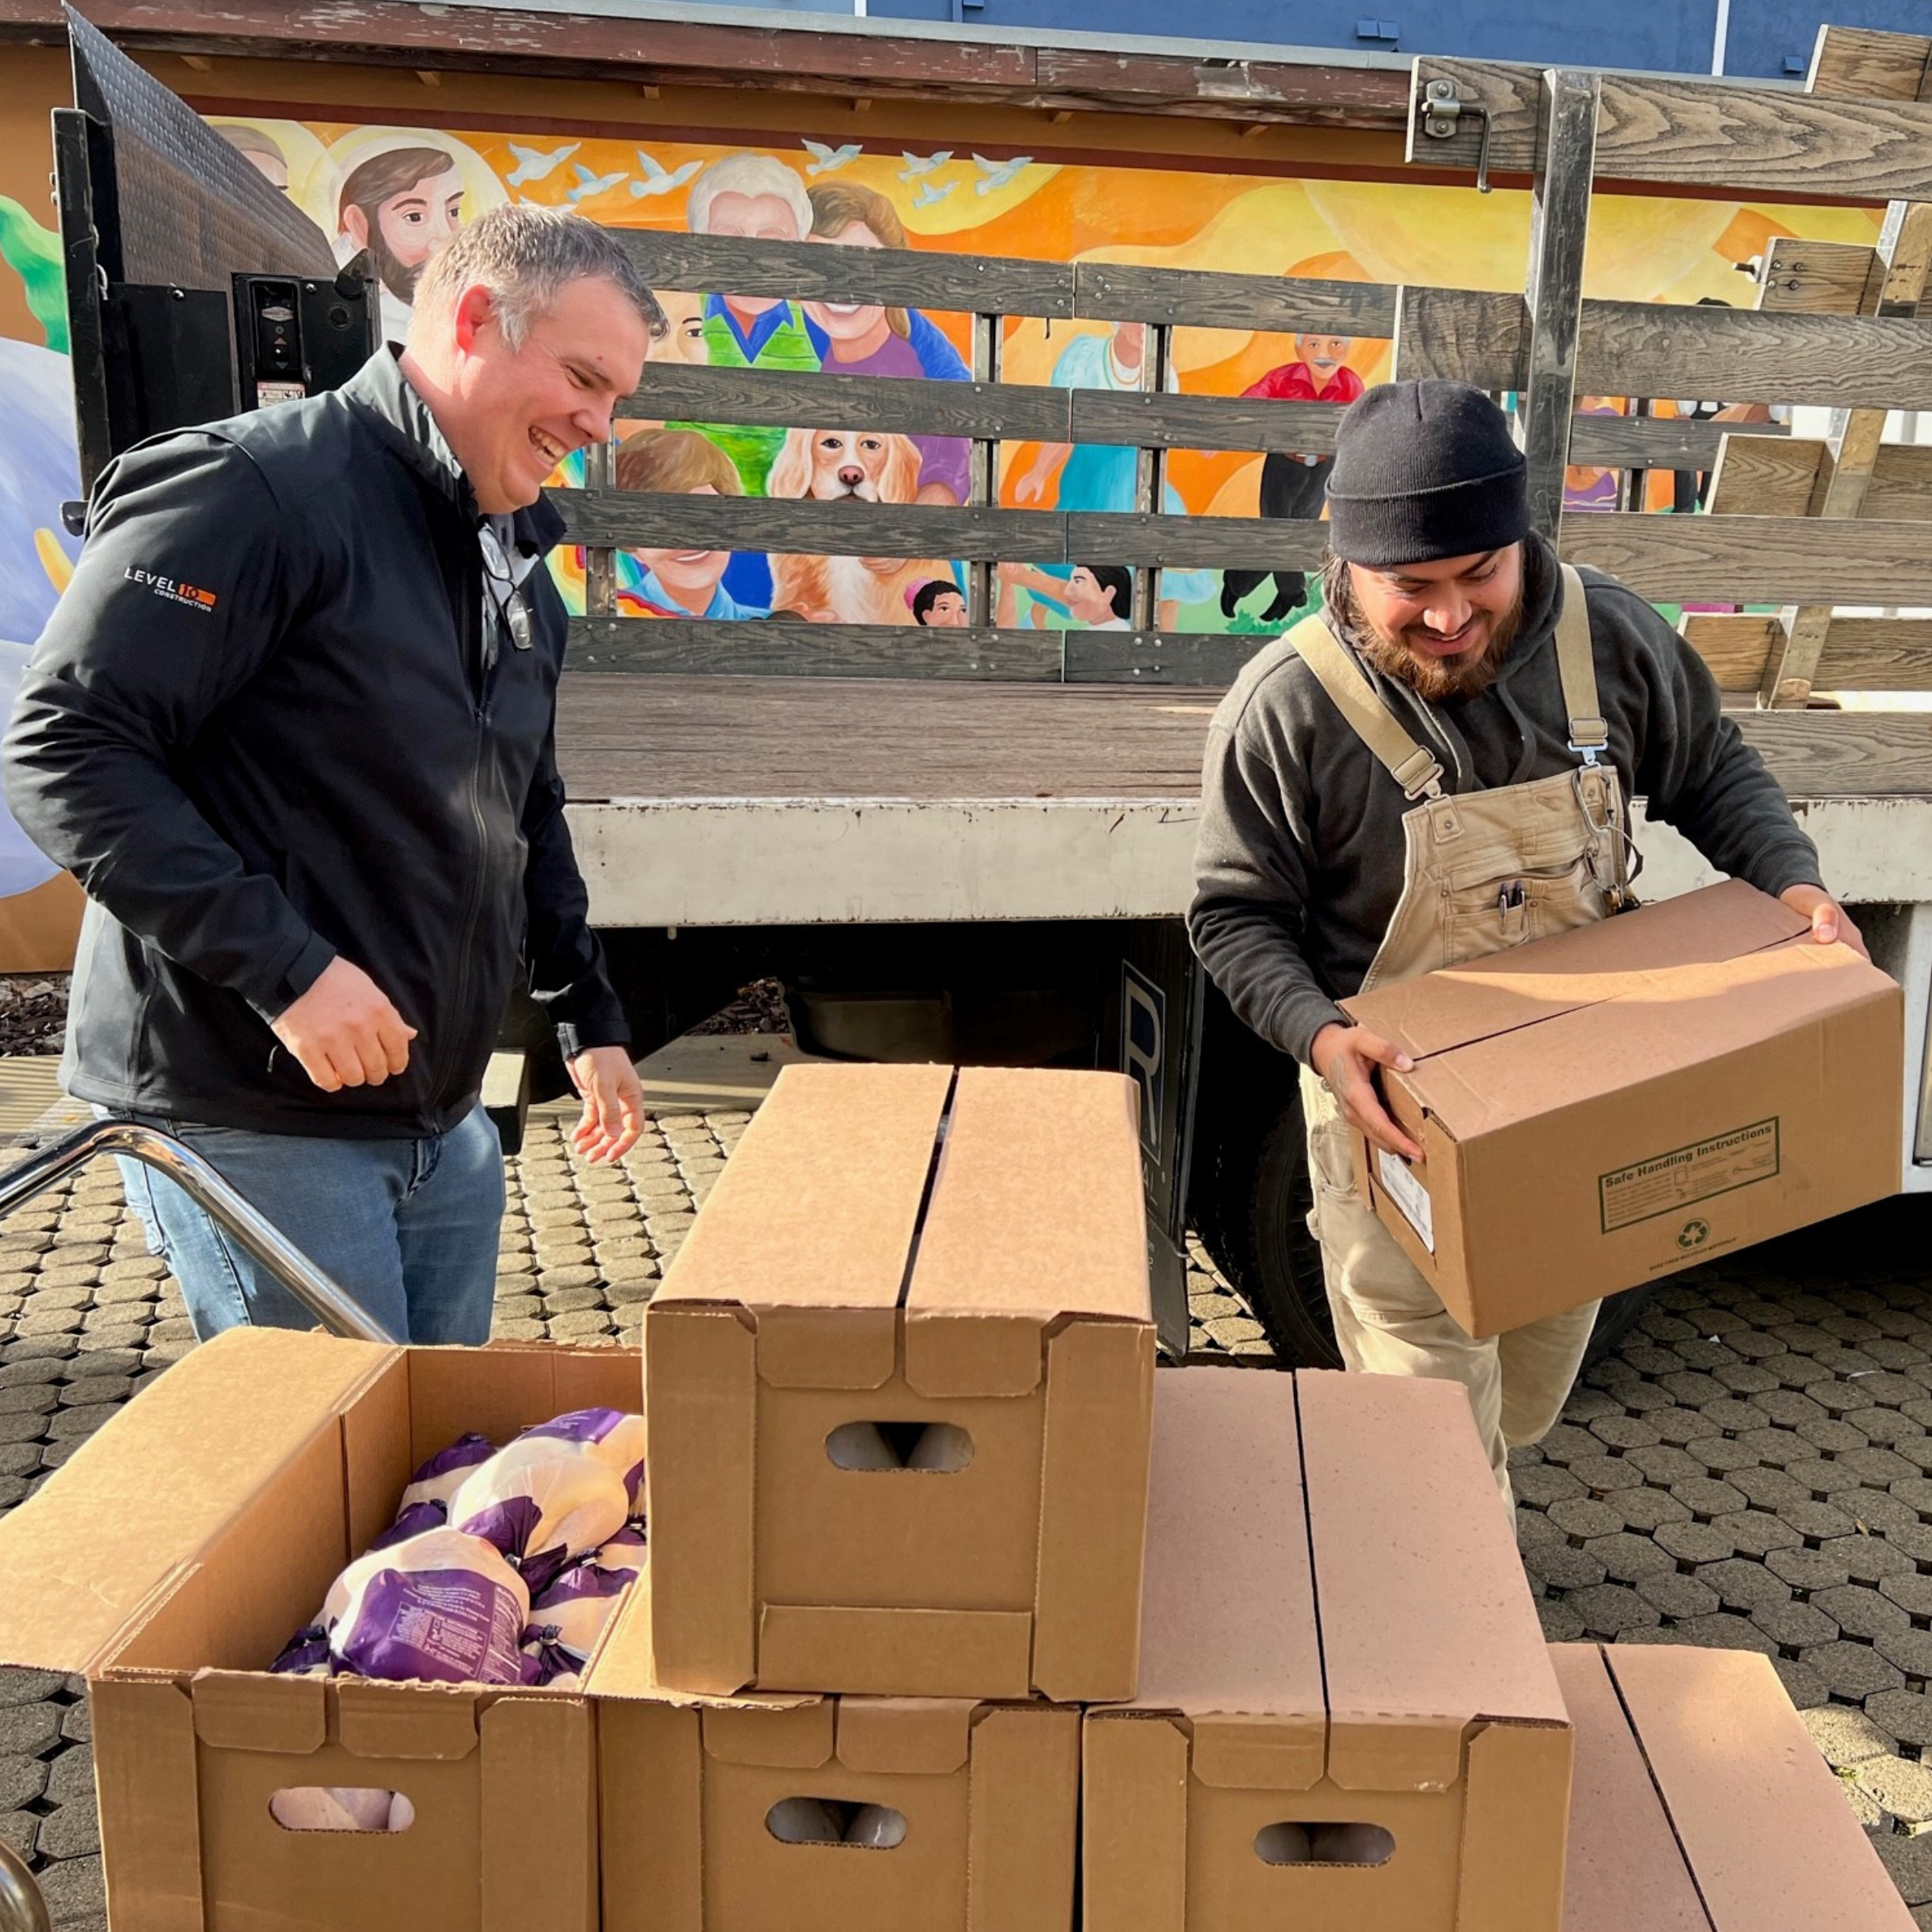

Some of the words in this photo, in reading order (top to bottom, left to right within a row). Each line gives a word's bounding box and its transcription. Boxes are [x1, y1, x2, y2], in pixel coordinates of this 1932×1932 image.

[123, 567, 176, 593] LEVEL
[153, 589, 212, 613] CONSTRUCTION
[1123, 975, 1162, 1147] R
[1605, 1171, 1634, 1188] Safe
[1637, 1151, 1694, 1178] Handling
[1697, 1124, 1773, 1157] Instructions
